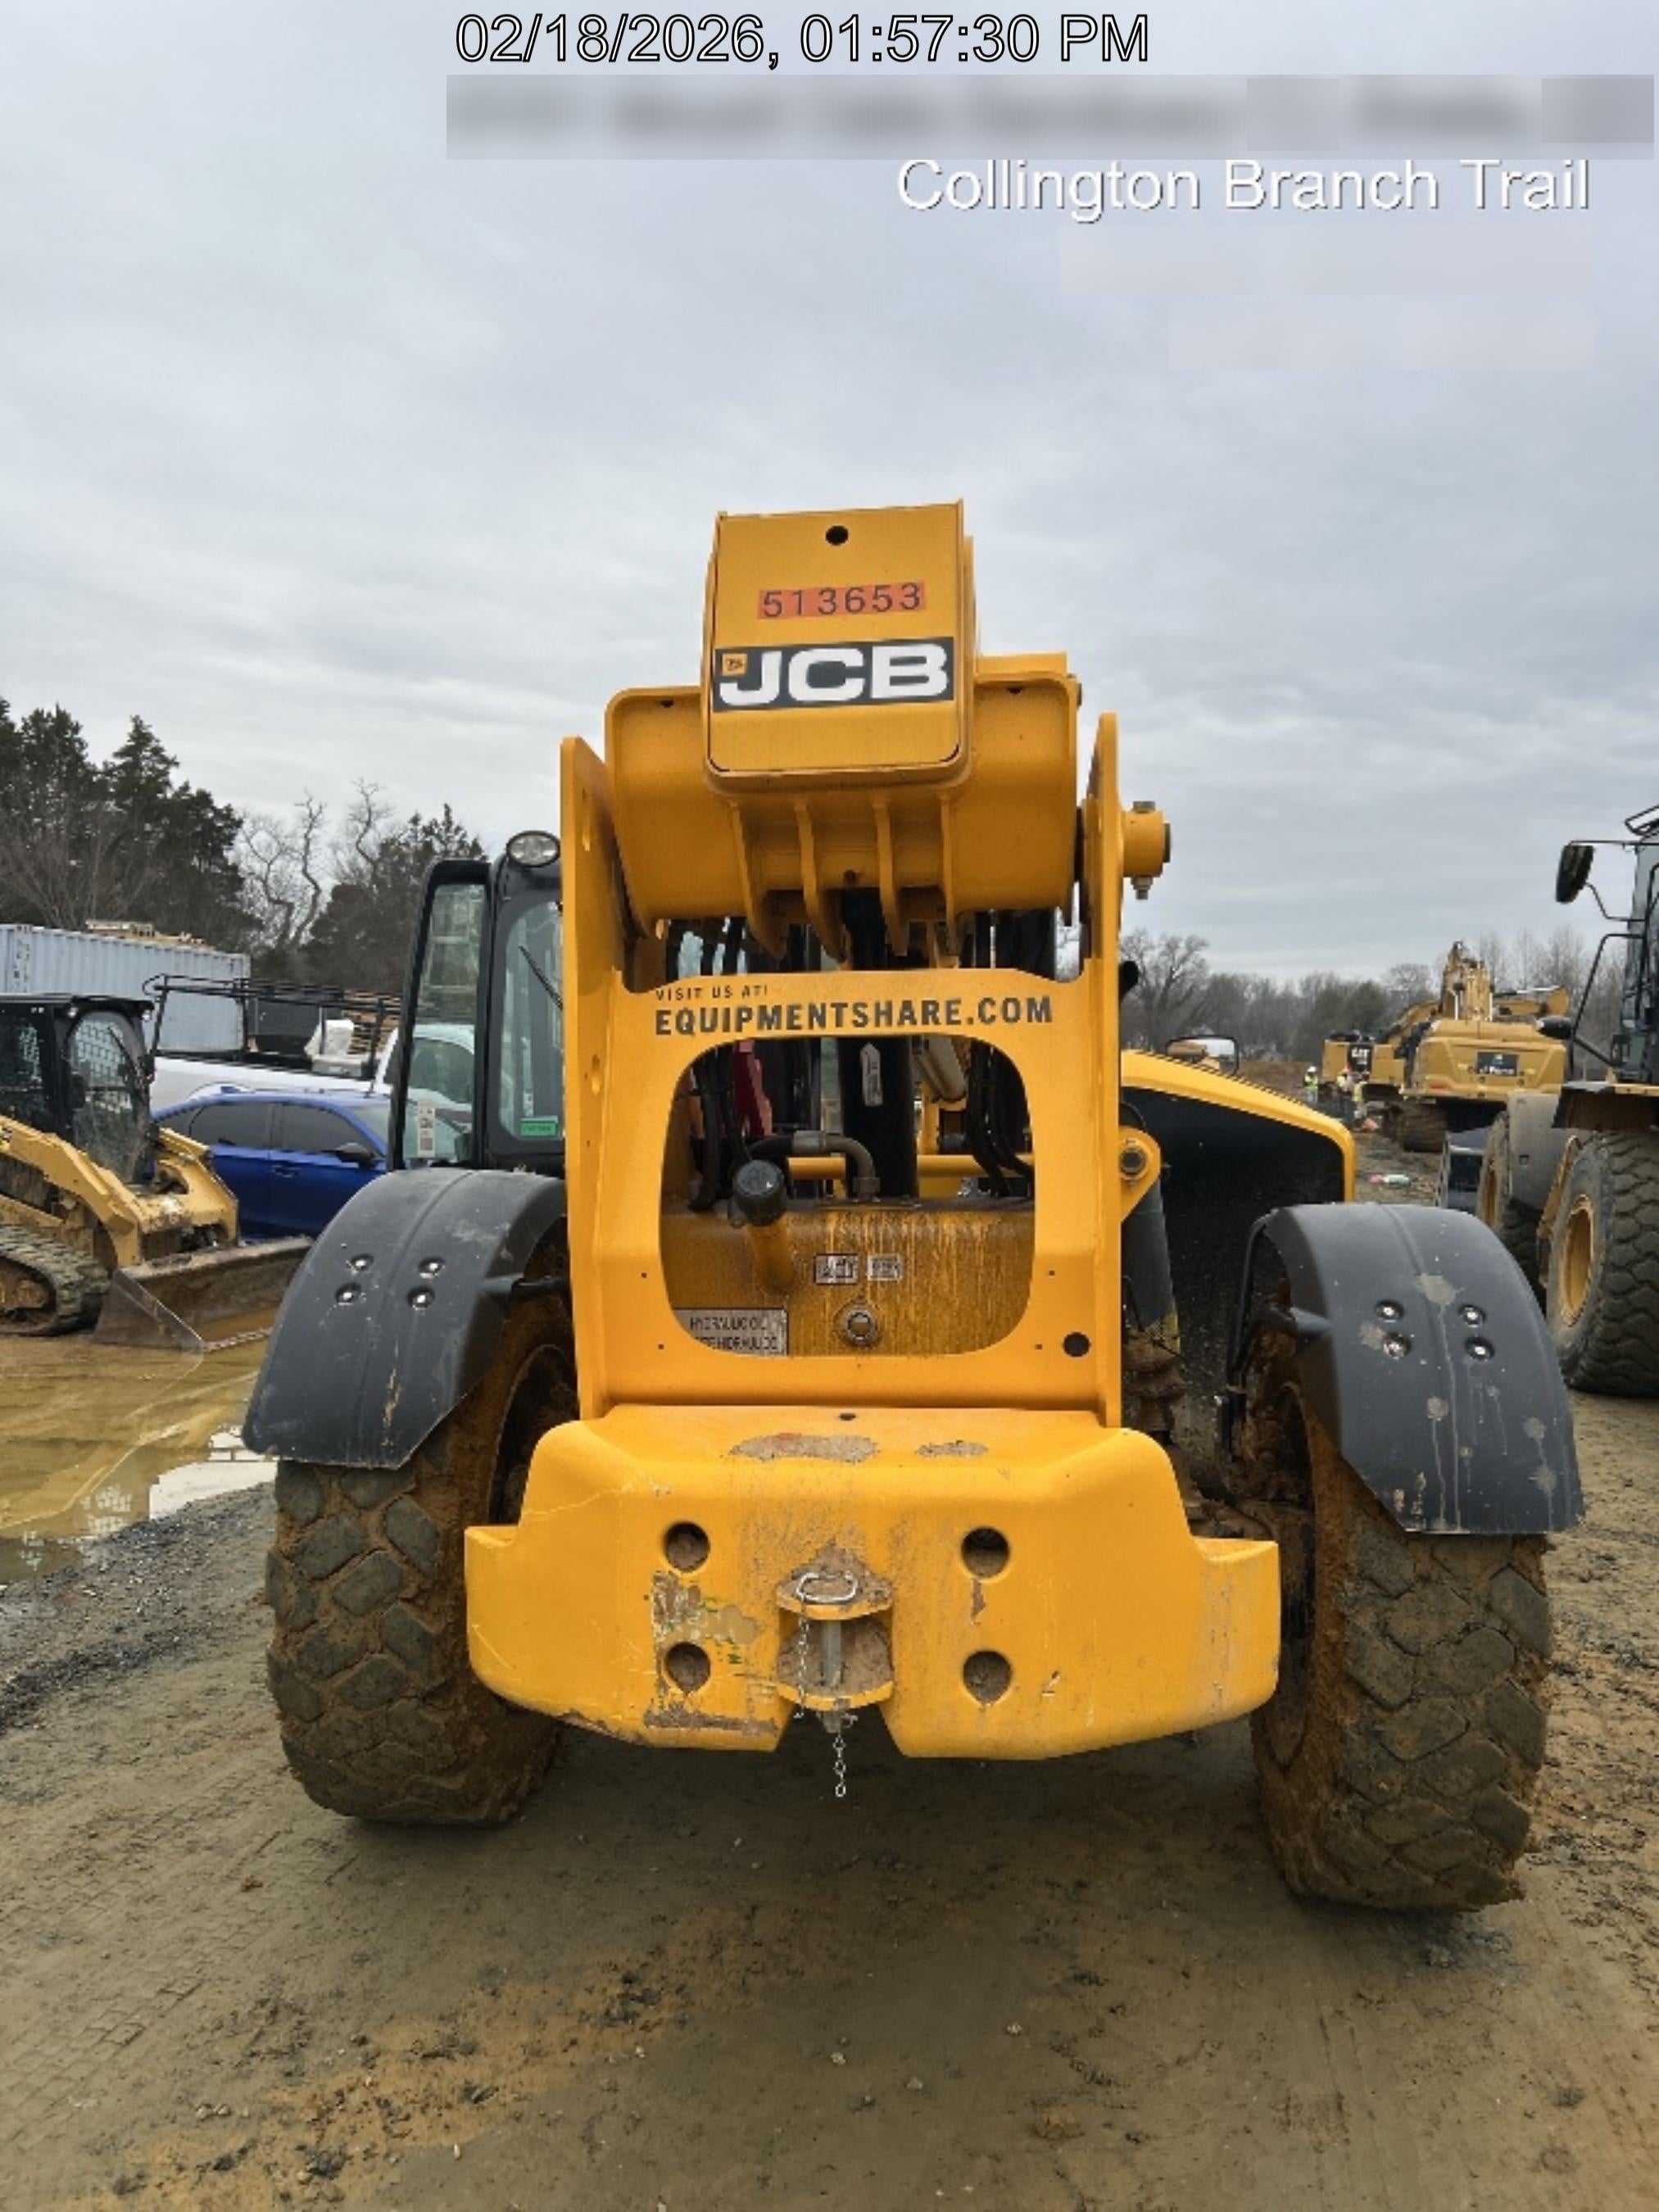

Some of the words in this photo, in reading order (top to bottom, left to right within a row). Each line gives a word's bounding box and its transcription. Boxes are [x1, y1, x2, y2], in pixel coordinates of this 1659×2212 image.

[762, 582, 922, 618] 513653
[719, 643, 949, 707] JCB
[655, 987, 702, 1001] VISIT
[712, 985, 733, 999] US
[655, 995, 1054, 1036] EQUIPMENTSHARE.COM
